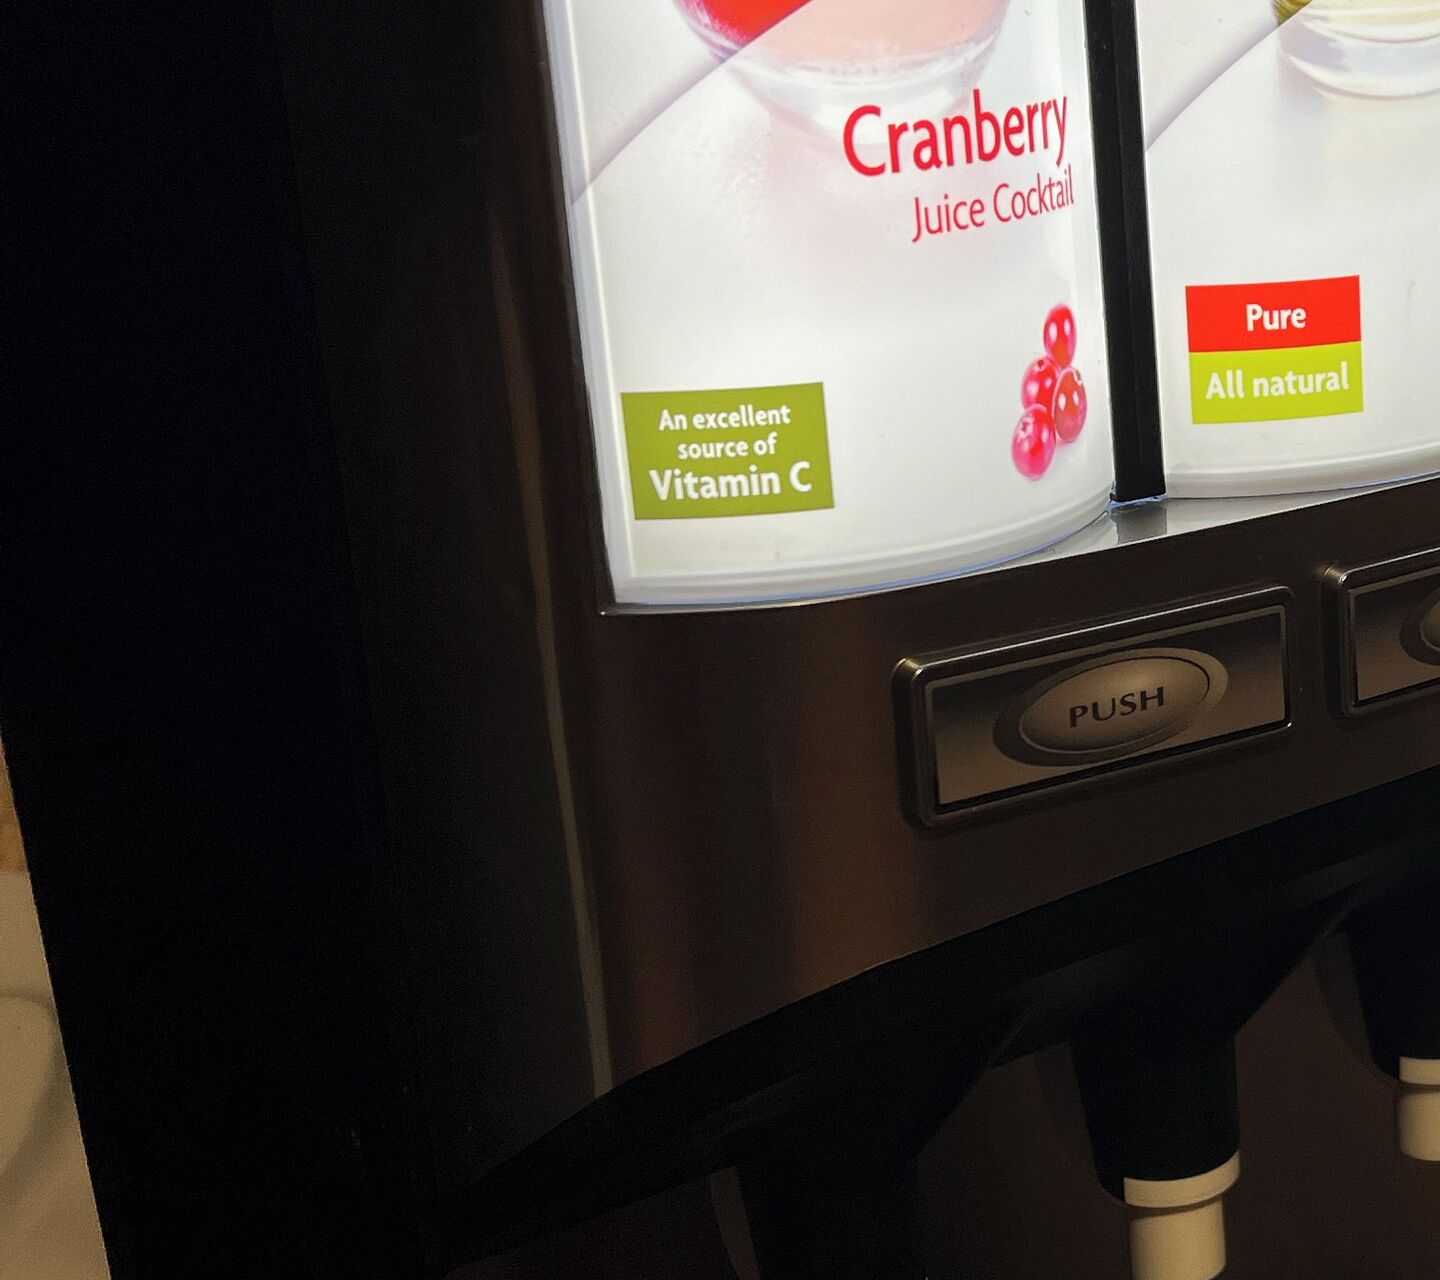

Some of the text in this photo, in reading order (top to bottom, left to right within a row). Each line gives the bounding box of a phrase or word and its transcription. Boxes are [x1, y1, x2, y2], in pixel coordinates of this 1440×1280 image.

[843, 88, 1067, 176] Cranberry
[912, 164, 1075, 243] Juice Cocktail
[1246, 303, 1307, 332] Pure
[1206, 361, 1350, 400] All natural
[659, 404, 791, 432] An excellent
[678, 431, 778, 460] source of
[650, 461, 812, 501] Vitamin C
[1069, 686, 1164, 728] PUSH
